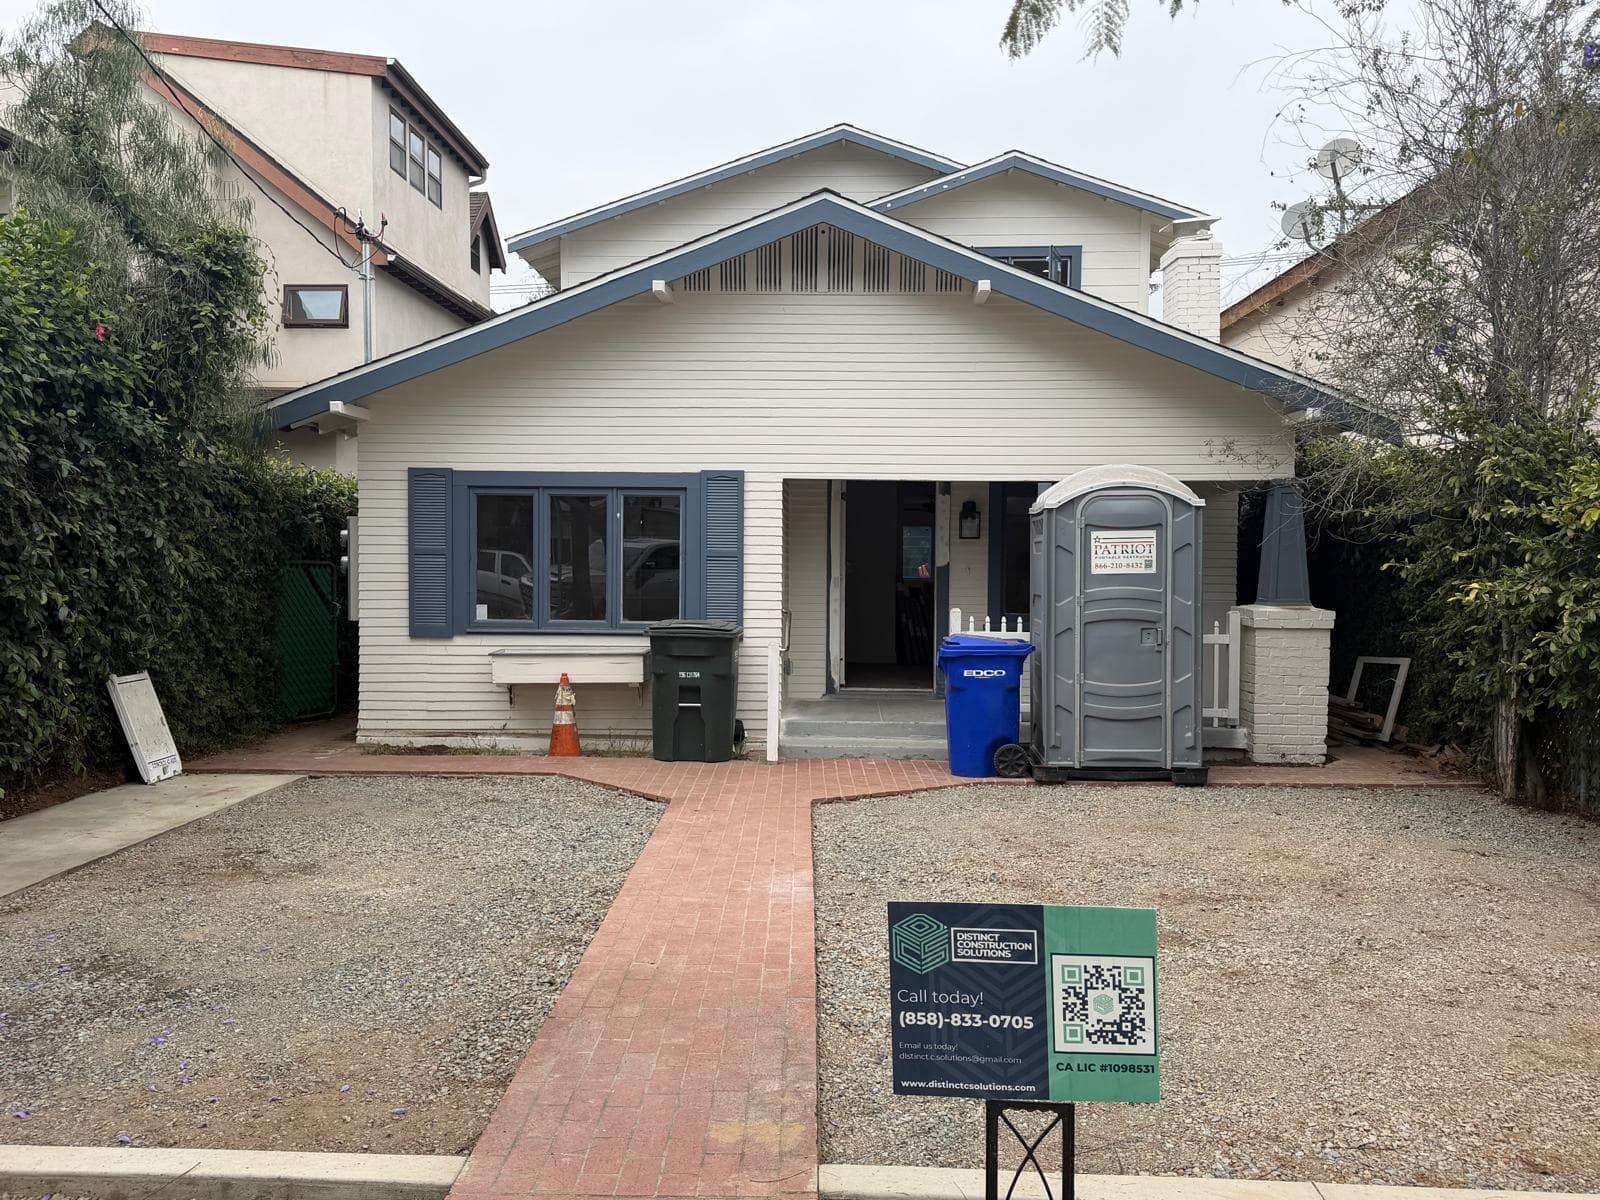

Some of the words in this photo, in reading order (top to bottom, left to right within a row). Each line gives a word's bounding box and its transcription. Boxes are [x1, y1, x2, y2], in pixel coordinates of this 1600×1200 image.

[1094, 543, 1154, 554] PATRIOT
[963, 669, 1006, 677] EDCO
[956, 932, 1001, 941] DISTINCT
[956, 940, 1033, 951] CONSTRUCTION
[956, 948, 1012, 958] SOLUTIONS
[897, 989, 927, 1003] Call
[931, 990, 984, 1008] today!
[899, 1010, 1034, 1030] (858)-833-0705
[899, 1041, 921, 1050] Email
[934, 1042, 959, 1052] today!
[1055, 1062, 1074, 1072] CA
[1077, 1062, 1097, 1073] LIC
[1099, 1063, 1155, 1074] #1098531
[900, 1079, 1036, 1093] www.distinctcsolutions.com
